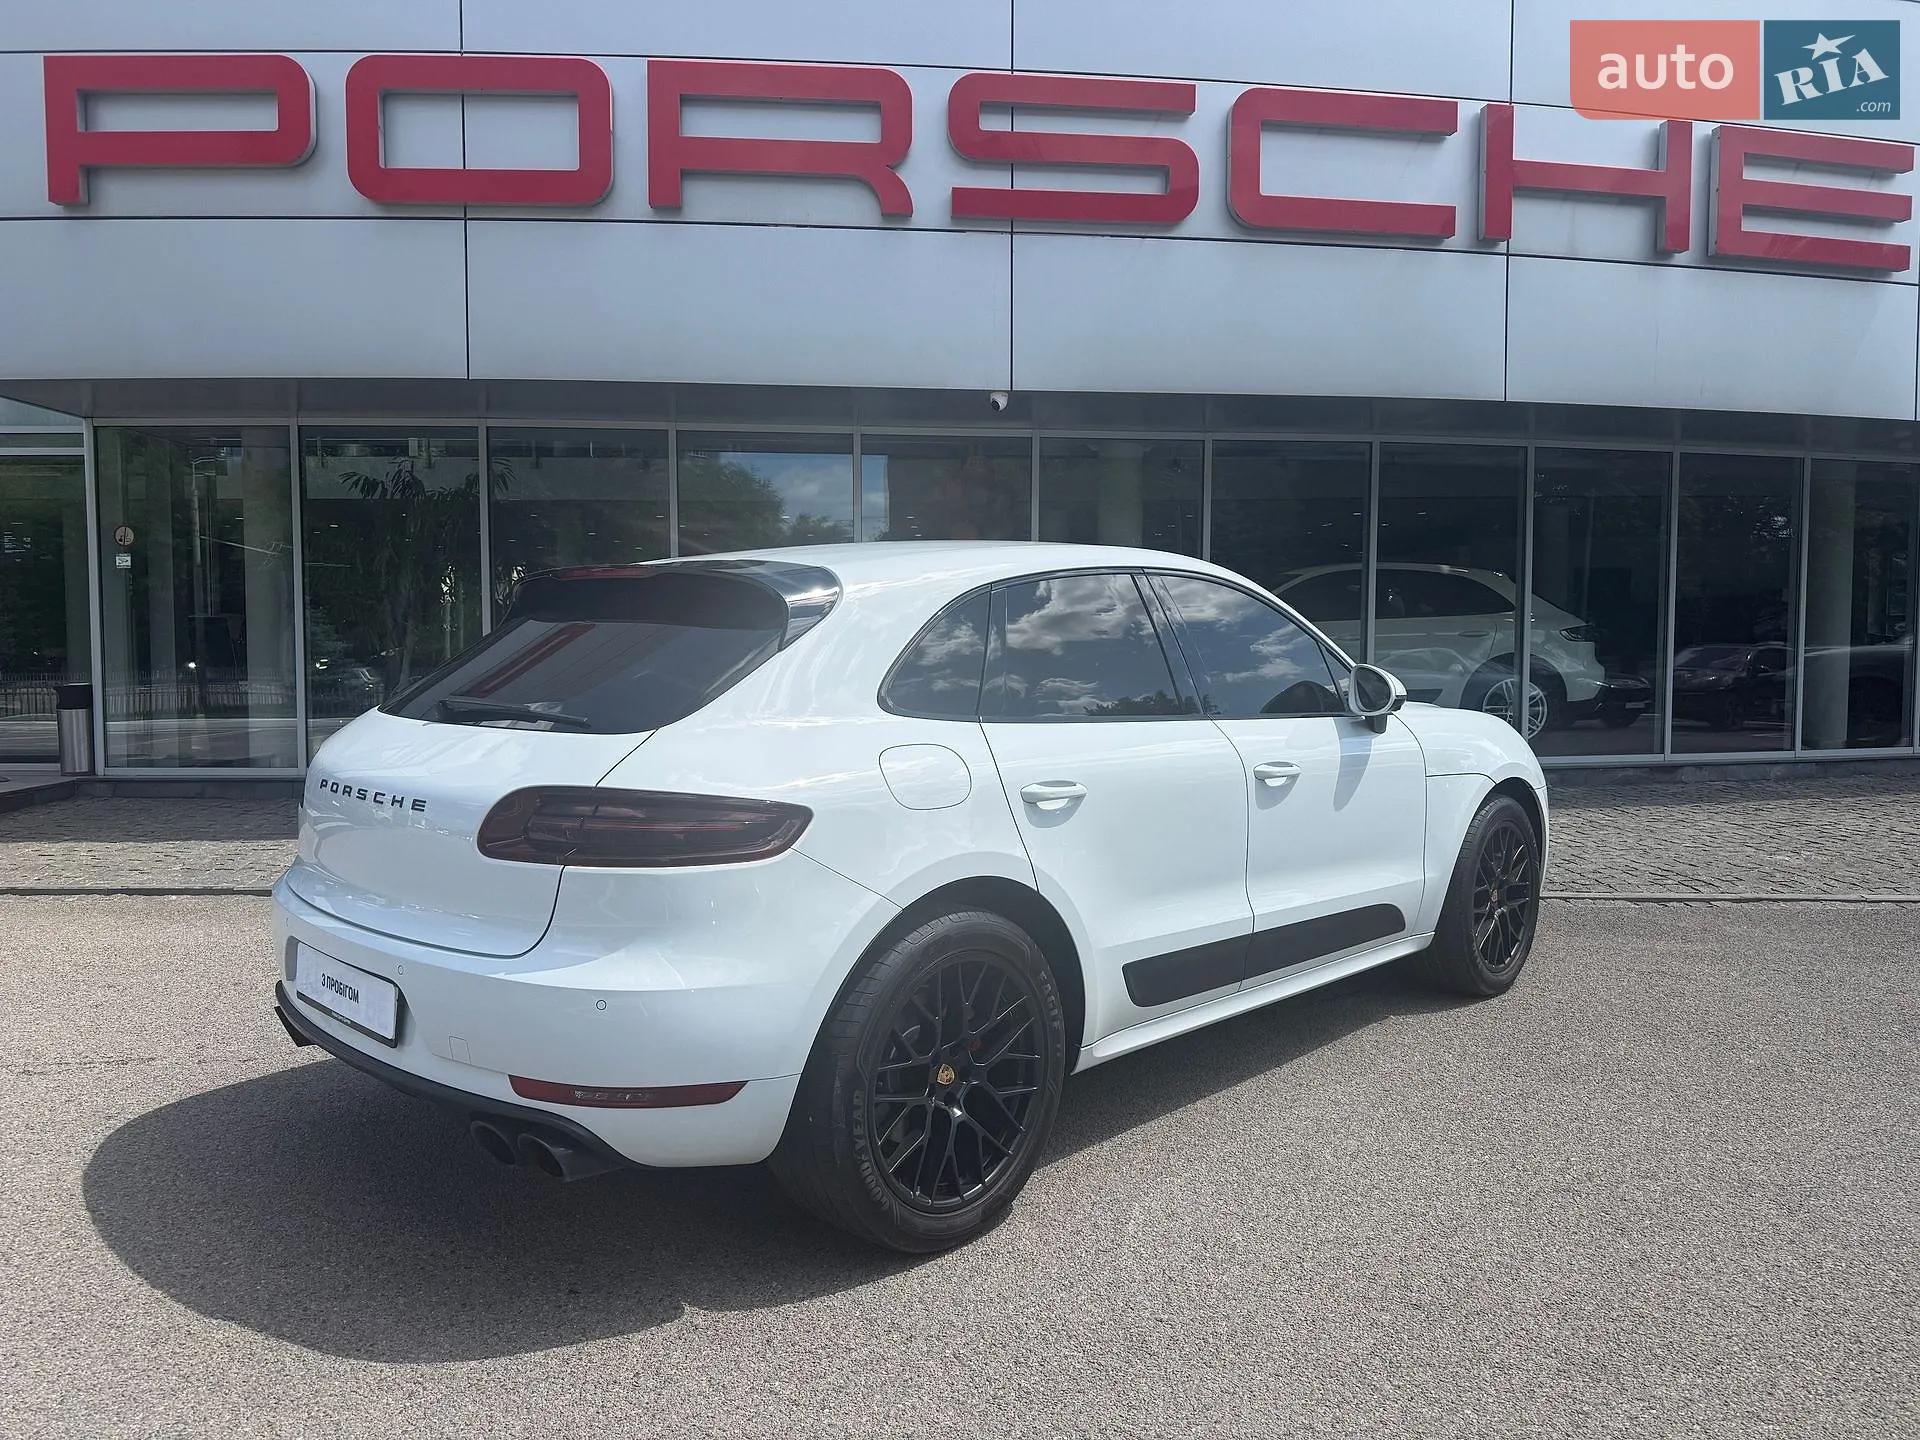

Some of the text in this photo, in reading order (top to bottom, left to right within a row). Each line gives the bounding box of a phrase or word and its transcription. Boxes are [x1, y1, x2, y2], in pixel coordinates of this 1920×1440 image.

[43, 54, 1915, 272] PORSCHE
[319, 778, 427, 813] PORSCHE
[326, 975, 359, 1004] ПРОБІГОМ
